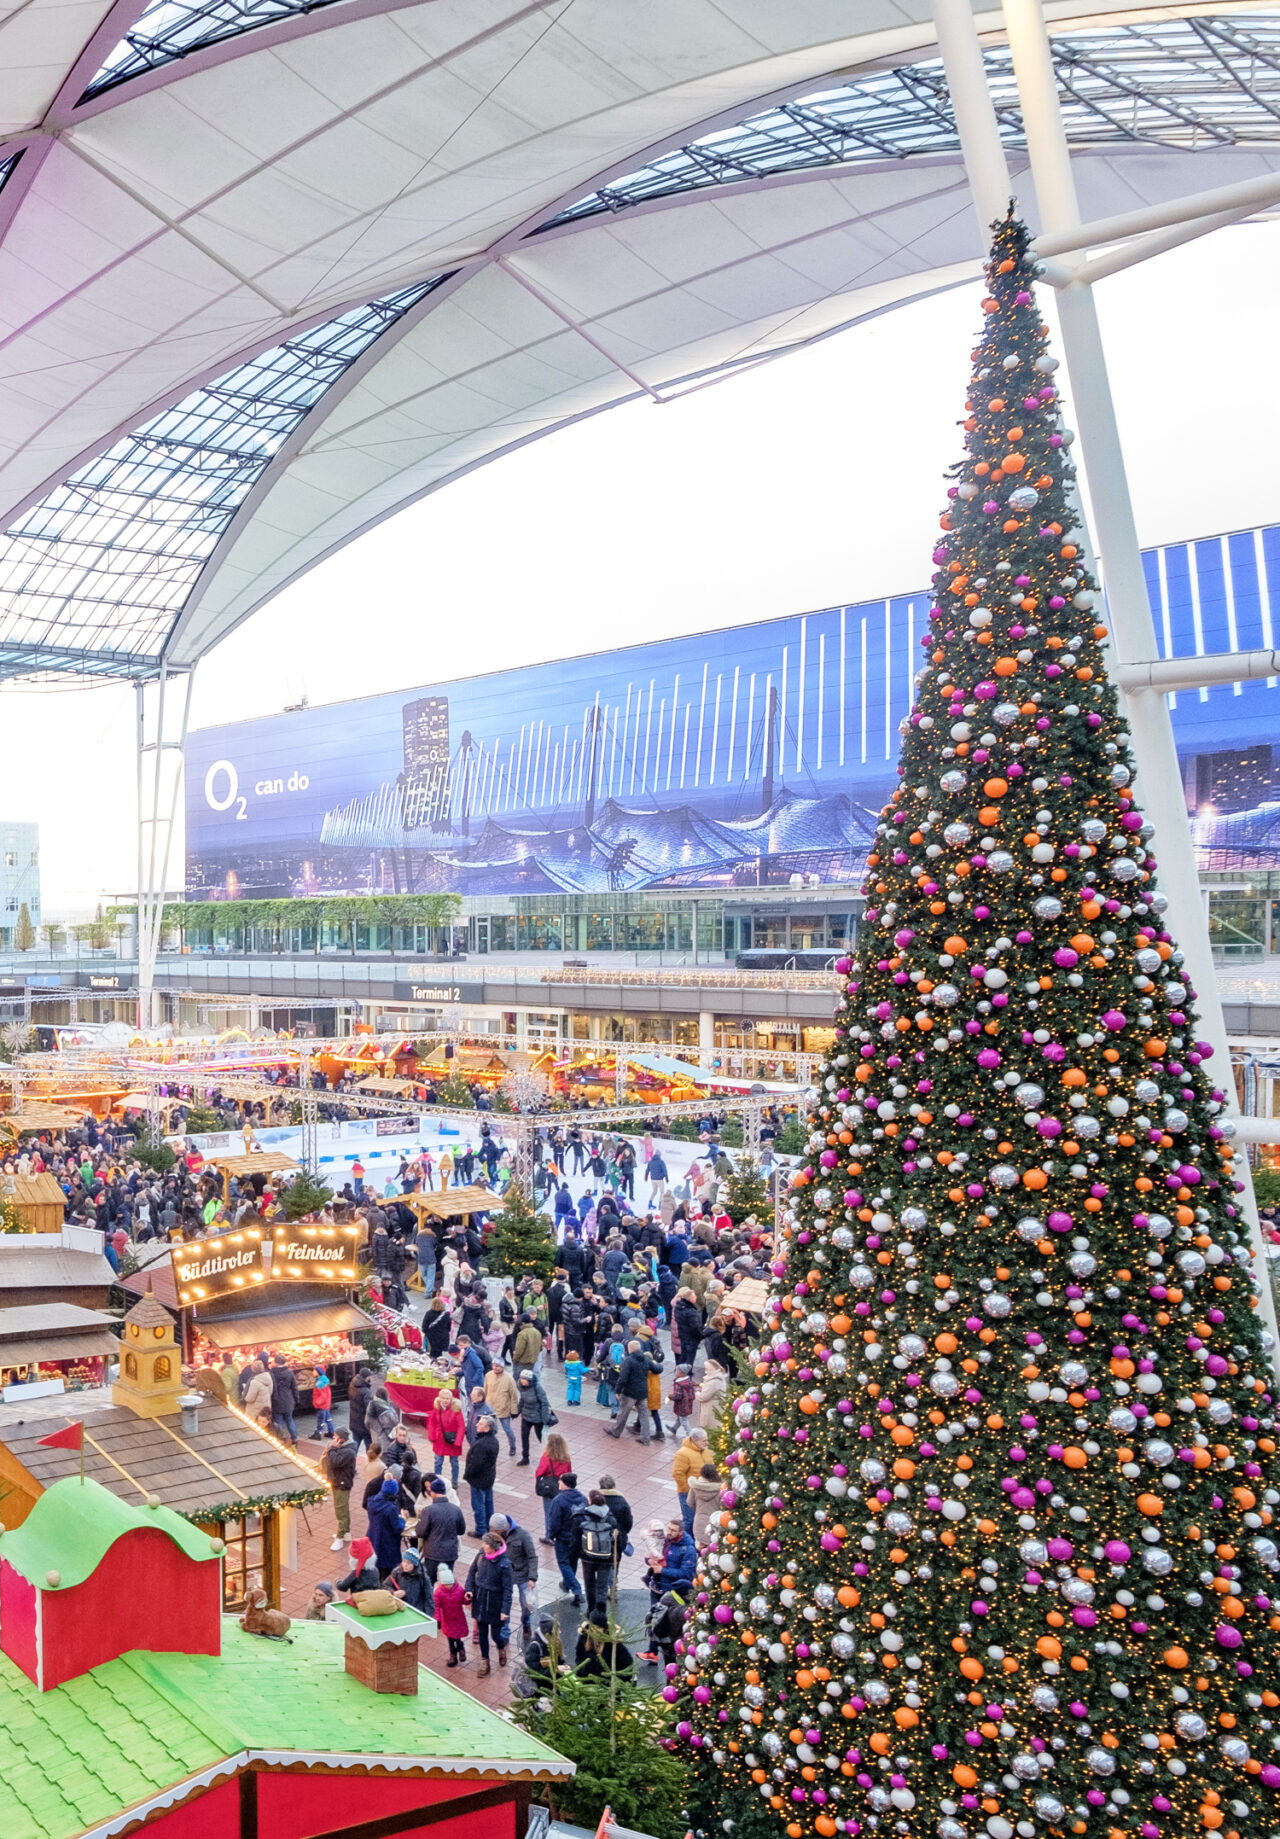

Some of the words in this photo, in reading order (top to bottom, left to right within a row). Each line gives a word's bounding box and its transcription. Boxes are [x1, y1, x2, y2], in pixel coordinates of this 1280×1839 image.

[254, 778, 283, 796] can
[287, 770, 309, 791] do
[411, 985, 452, 1000] Terminal
[453, 987, 461, 1001] 2
[180, 1250, 256, 1282] Südtiroler
[287, 1243, 346, 1262] Feinkost
